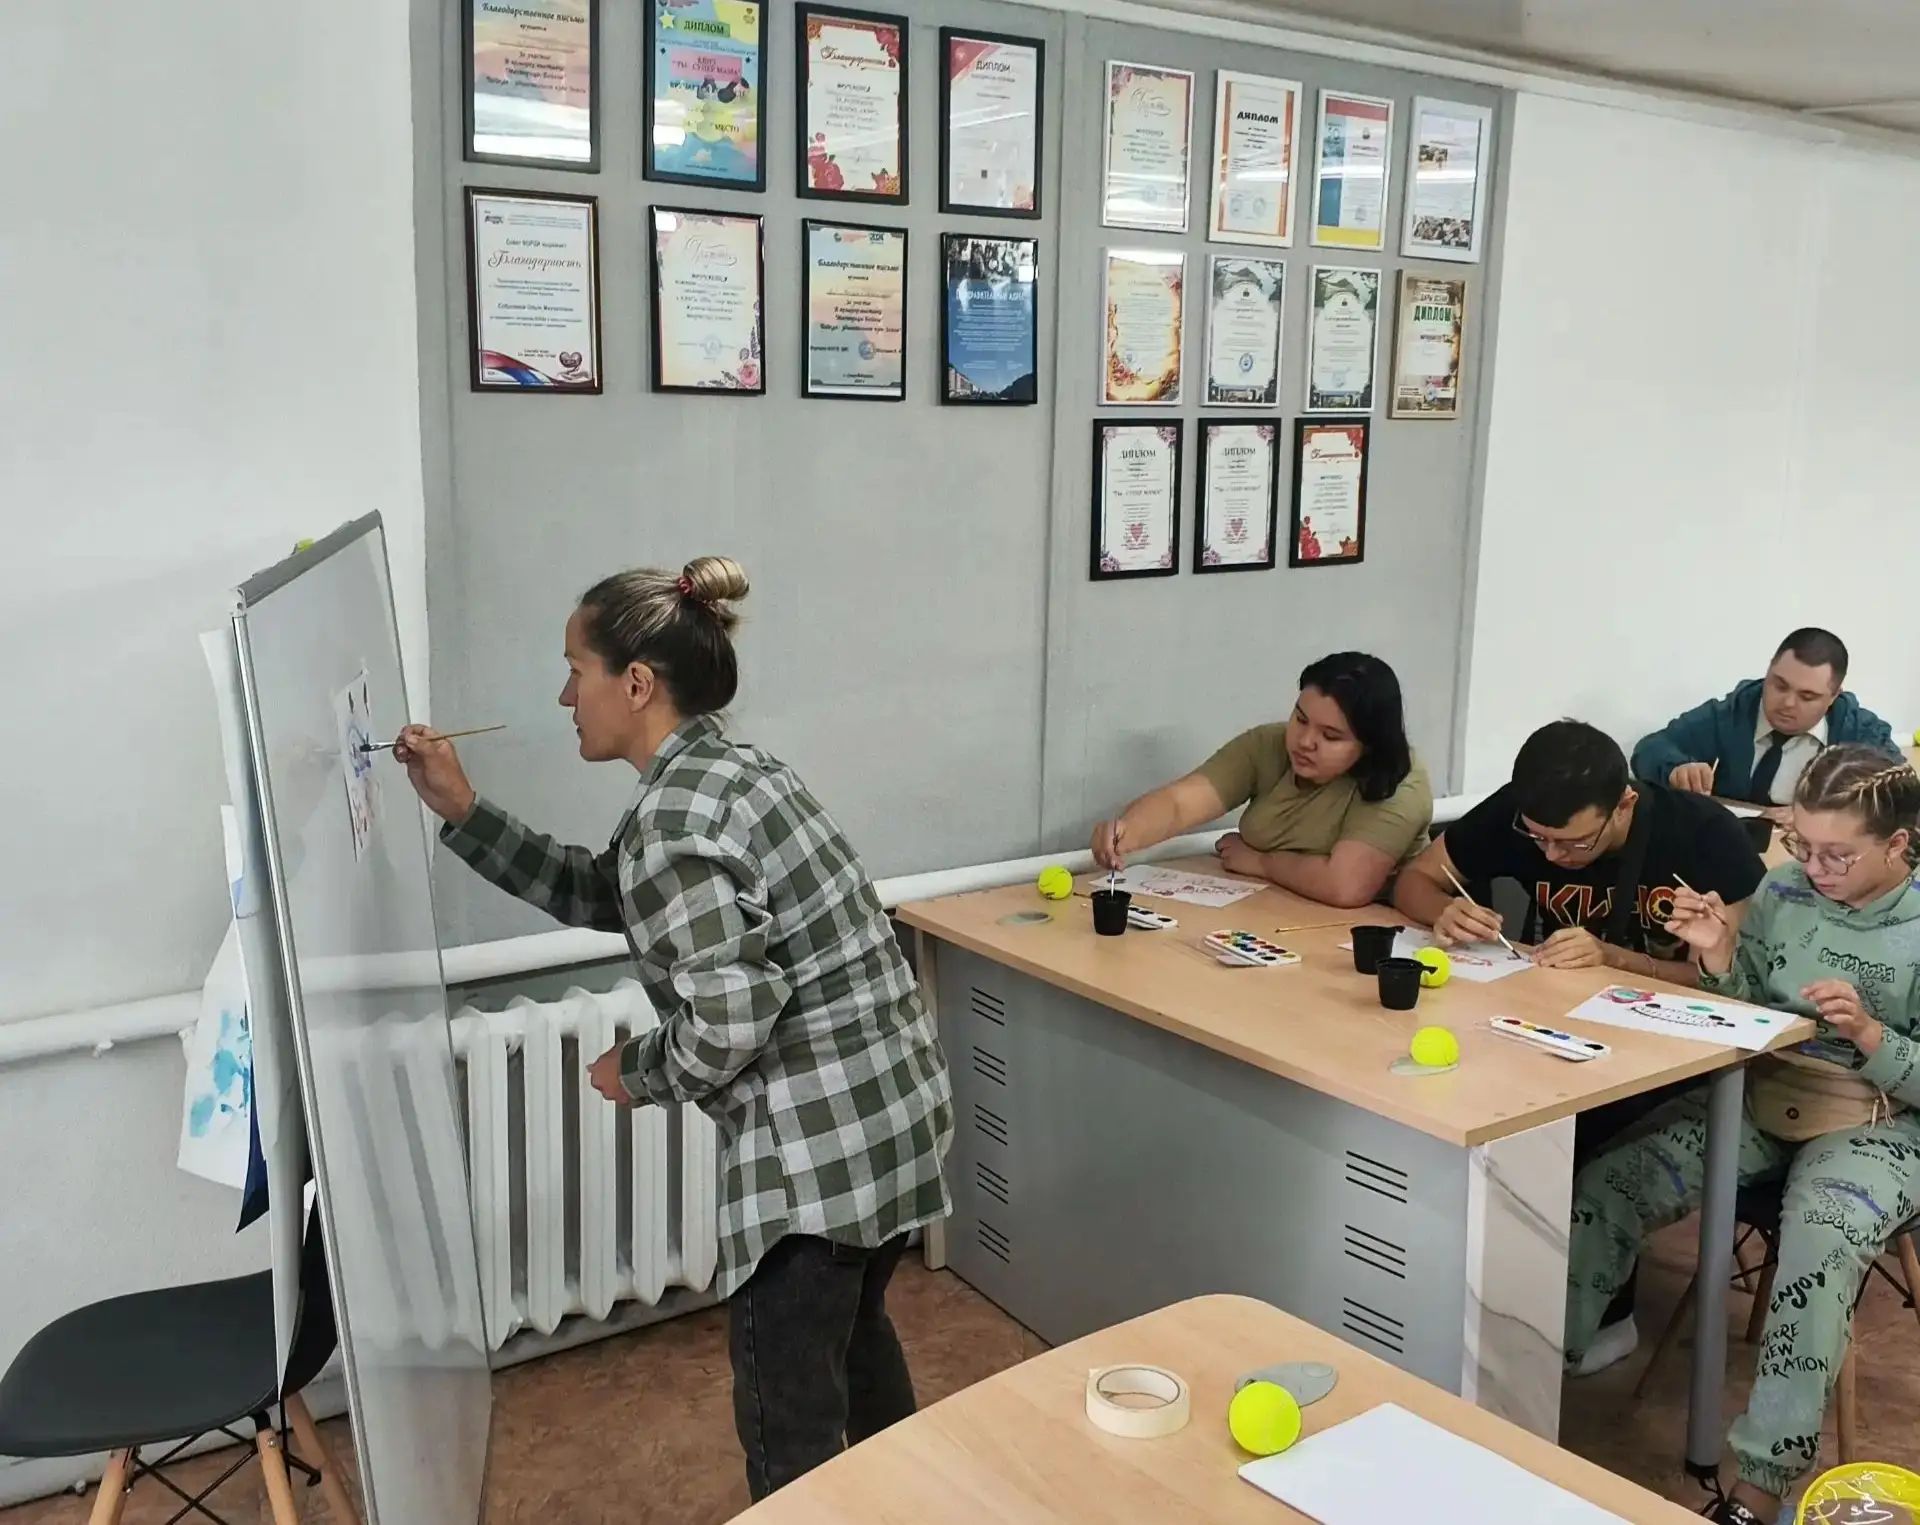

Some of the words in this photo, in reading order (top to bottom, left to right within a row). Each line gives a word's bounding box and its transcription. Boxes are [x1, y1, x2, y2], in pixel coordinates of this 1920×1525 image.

[684, 20, 724, 35] ДИПЛОМ
[976, 60, 1011, 73] ДИПЛОМ
[1236, 111, 1278, 124] ДИПЛОМ
[487, 249, 582, 272] Благодарность
[1413, 305, 1452, 321] ДИПЛОМ
[1888, 1161, 1911, 1178] NOW
[1770, 1271, 1826, 1314] ENJOY
[1757, 1356, 1829, 1379] ERATION
